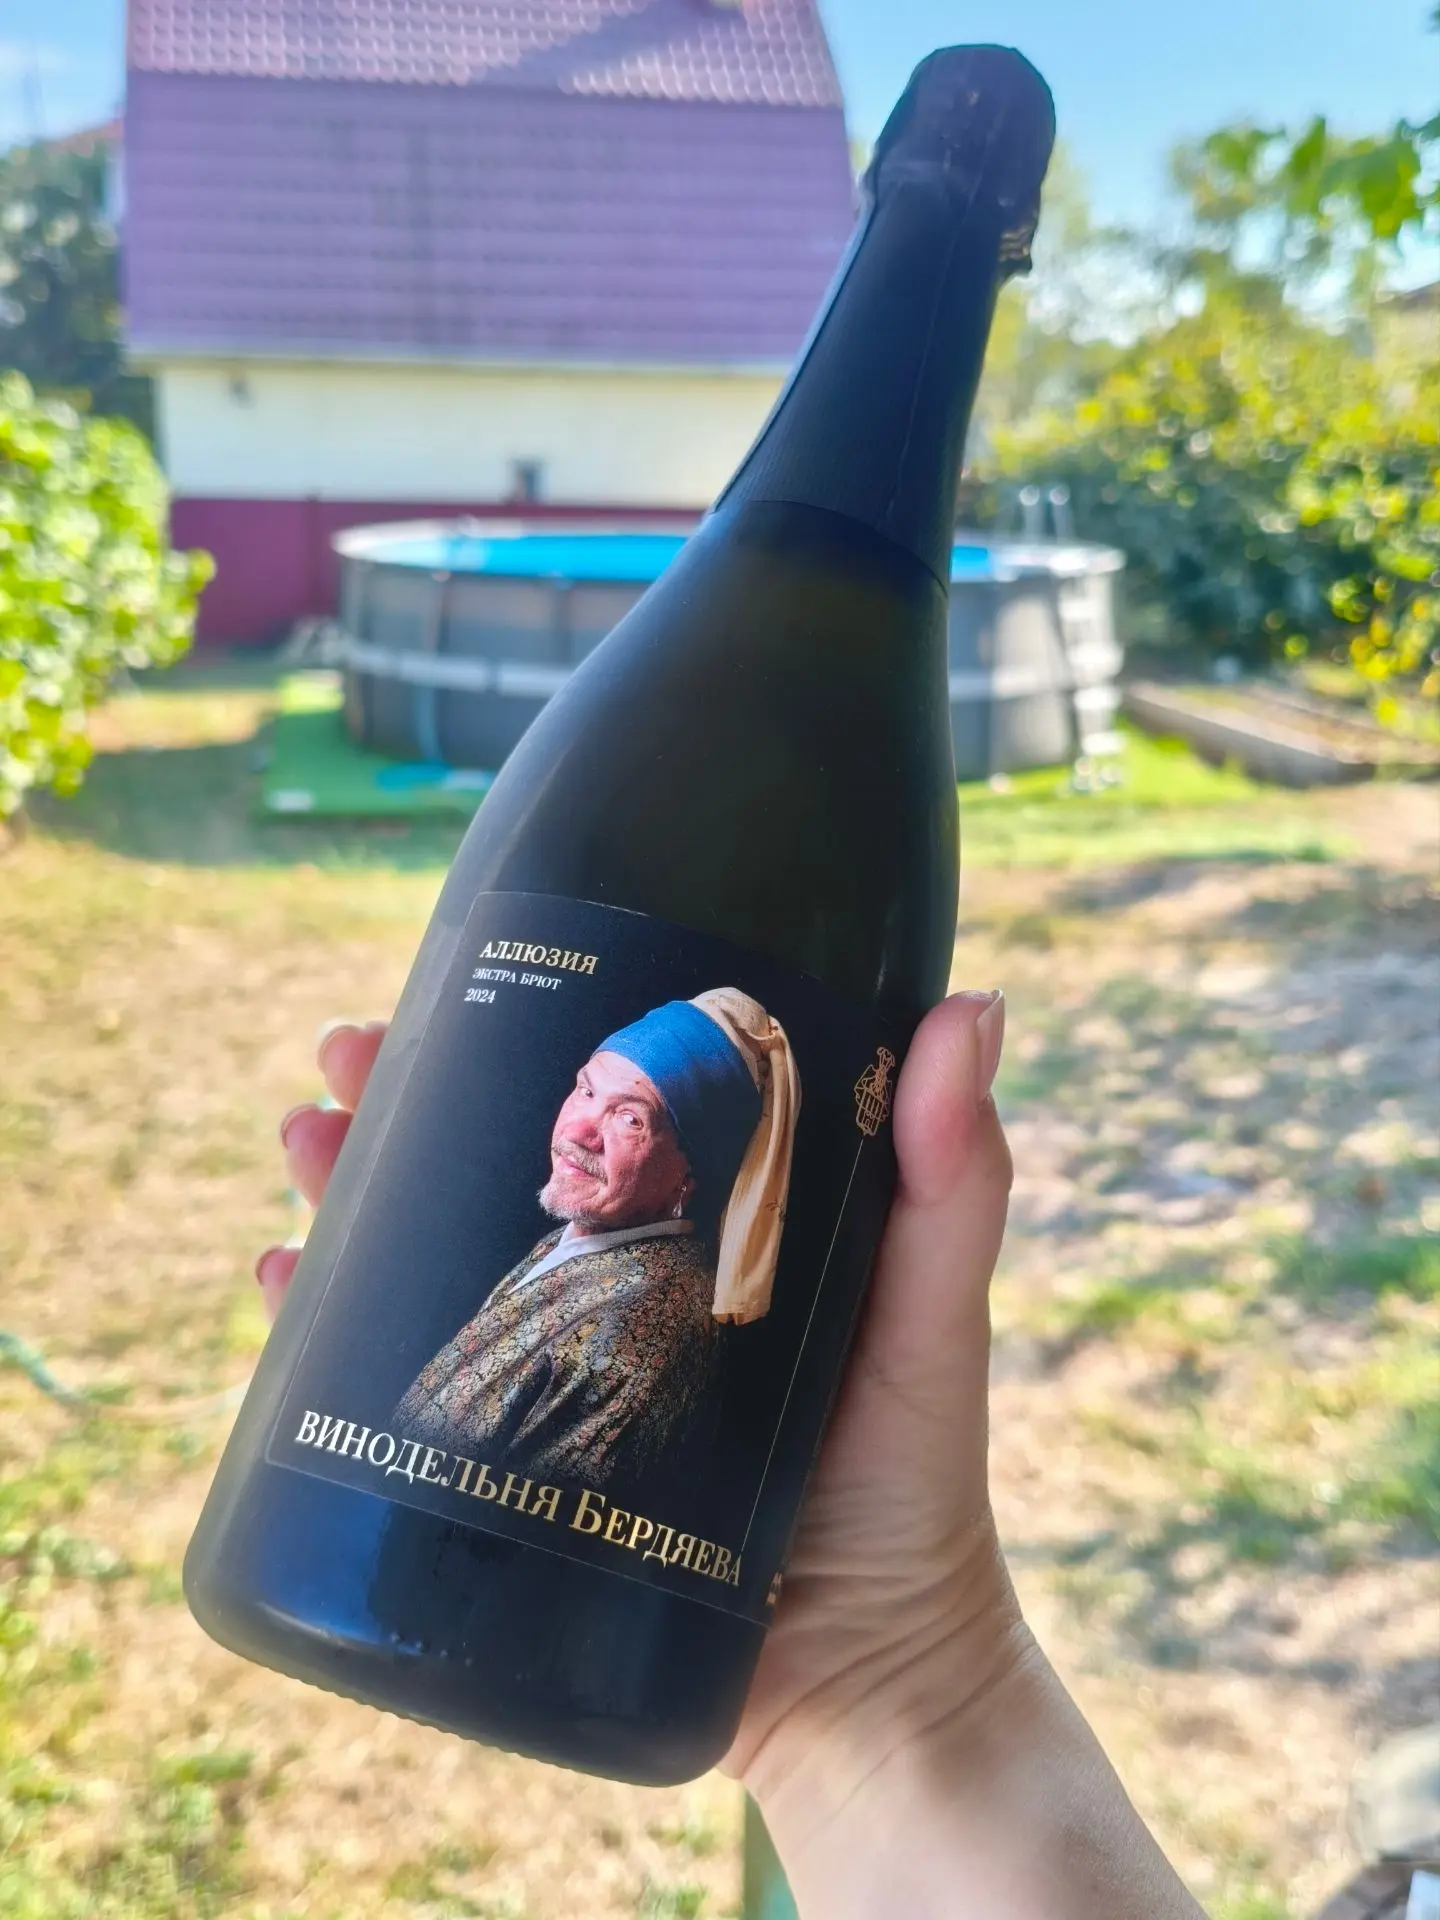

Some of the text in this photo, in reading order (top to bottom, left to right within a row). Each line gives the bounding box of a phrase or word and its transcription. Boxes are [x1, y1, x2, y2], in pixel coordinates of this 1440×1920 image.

[479, 941, 599, 974] АЛЛЮЗИЯ
[472, 968, 562, 990] ЭКСТРА БРЮТ
[464, 988, 496, 1003] 2024
[296, 1410, 564, 1521] ВИНОДЕЛЬНЯ
